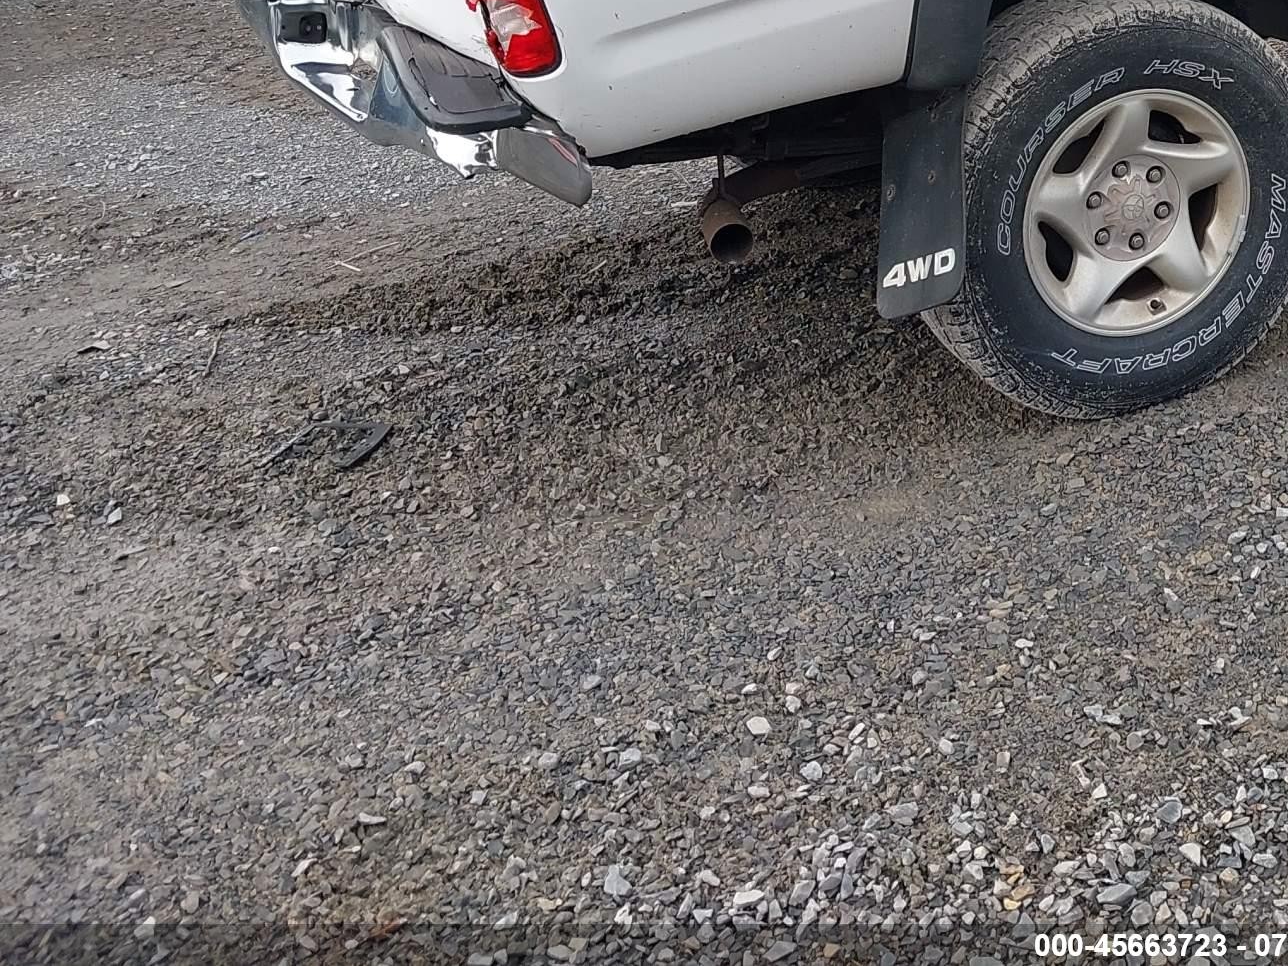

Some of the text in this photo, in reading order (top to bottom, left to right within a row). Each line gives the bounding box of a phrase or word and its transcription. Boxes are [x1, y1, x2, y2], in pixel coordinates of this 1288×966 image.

[997, 59, 1235, 256] COURSER HSX
[882, 247, 956, 288] 4WD
[1051, 173, 1287, 375] MASTERCRAFT
